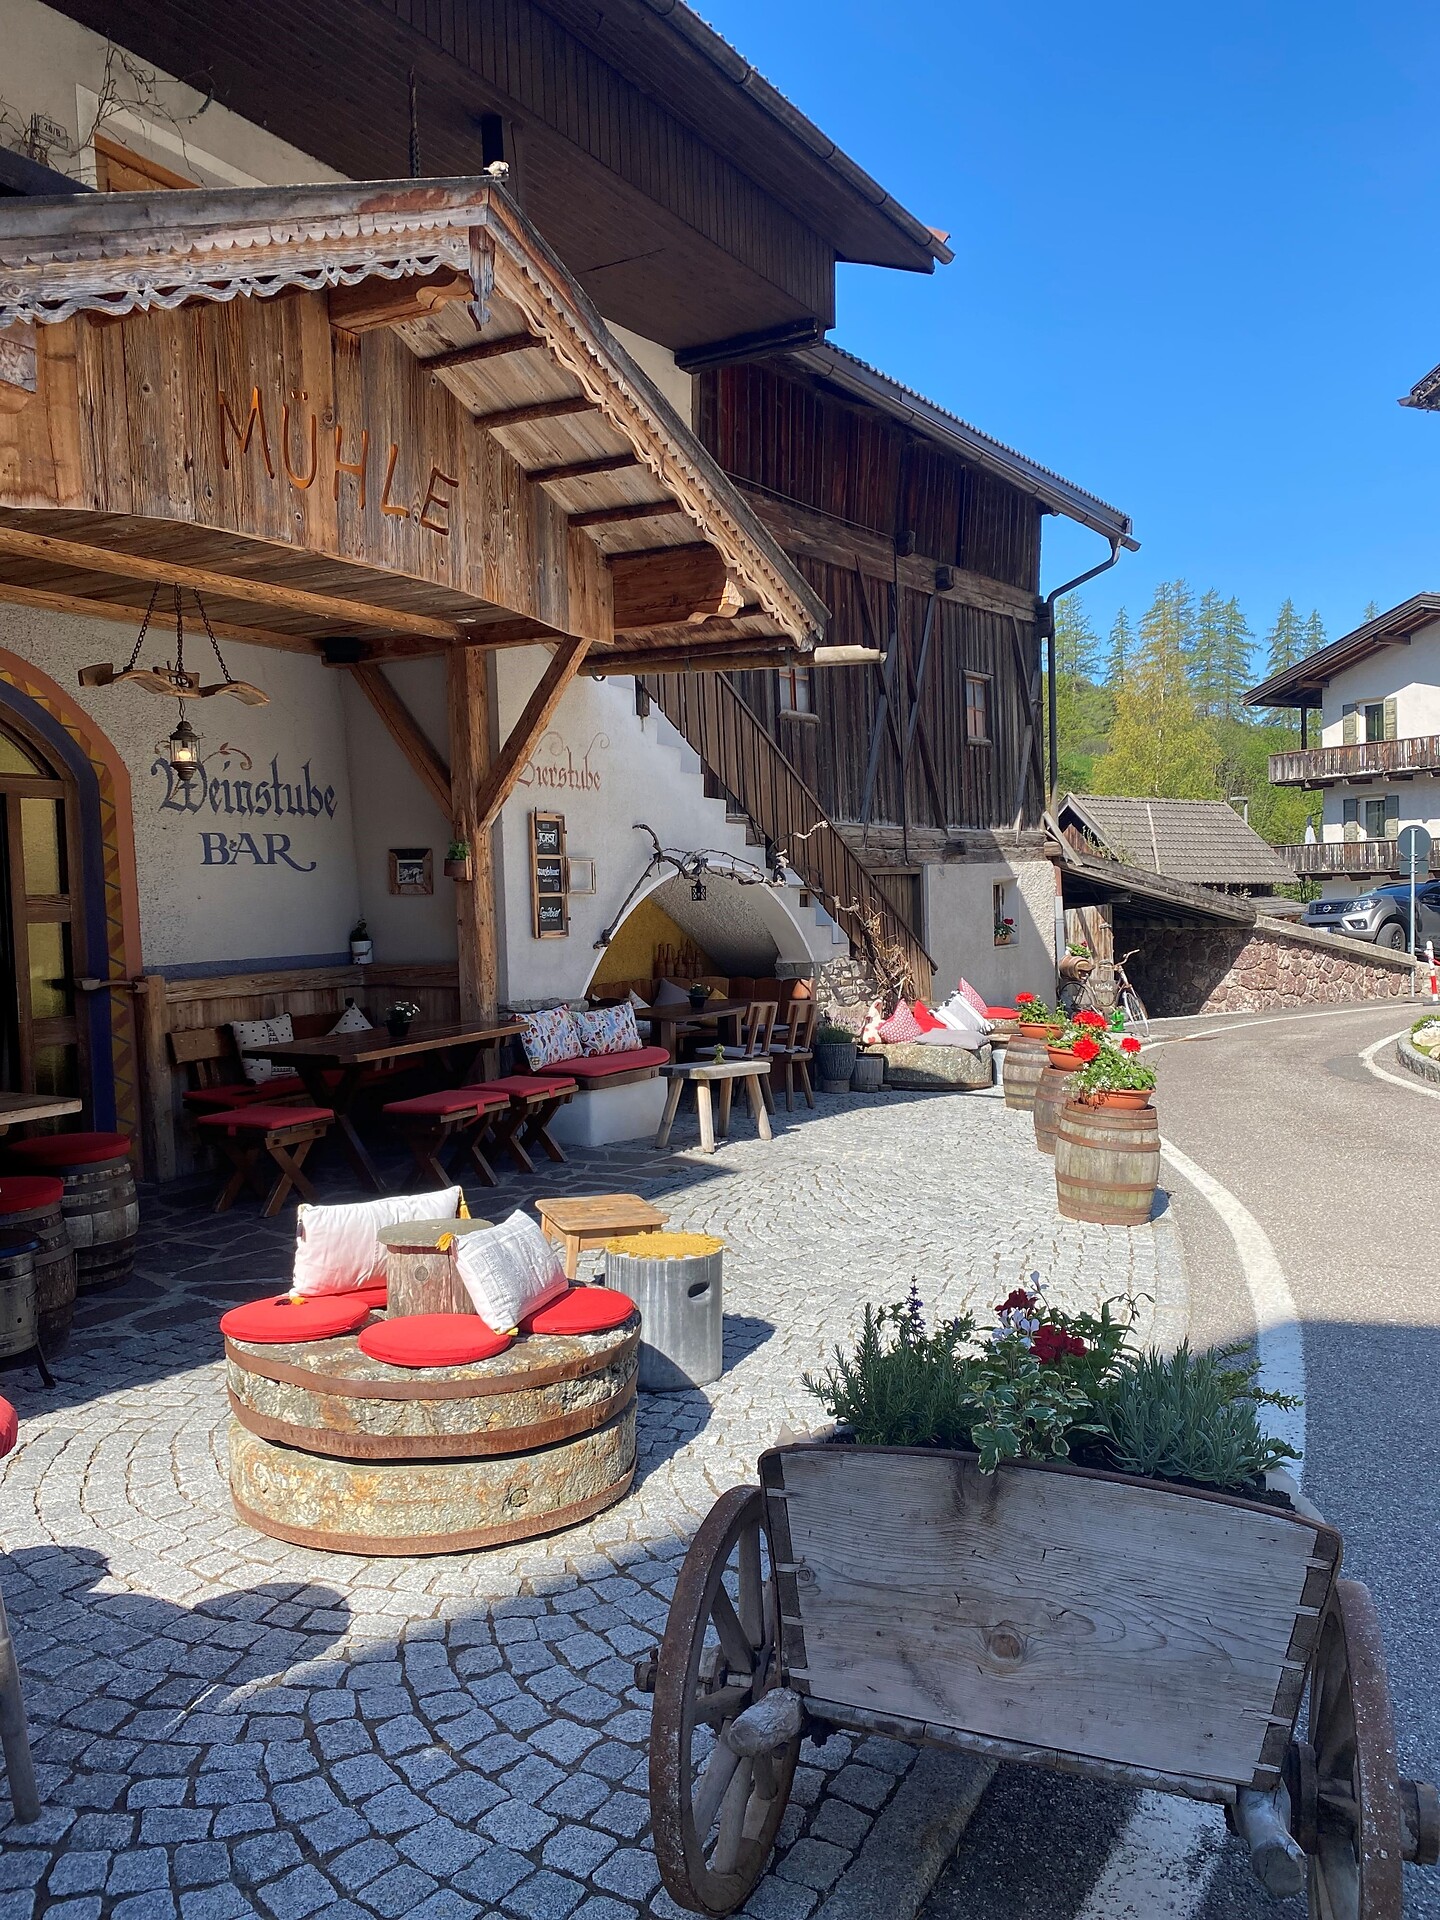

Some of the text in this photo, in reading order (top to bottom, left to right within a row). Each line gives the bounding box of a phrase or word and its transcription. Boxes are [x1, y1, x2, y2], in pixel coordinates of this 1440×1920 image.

[218, 385, 459, 536] MÜHLE
[151, 753, 338, 820] Weinstube
[198, 832, 317, 872] BAR
